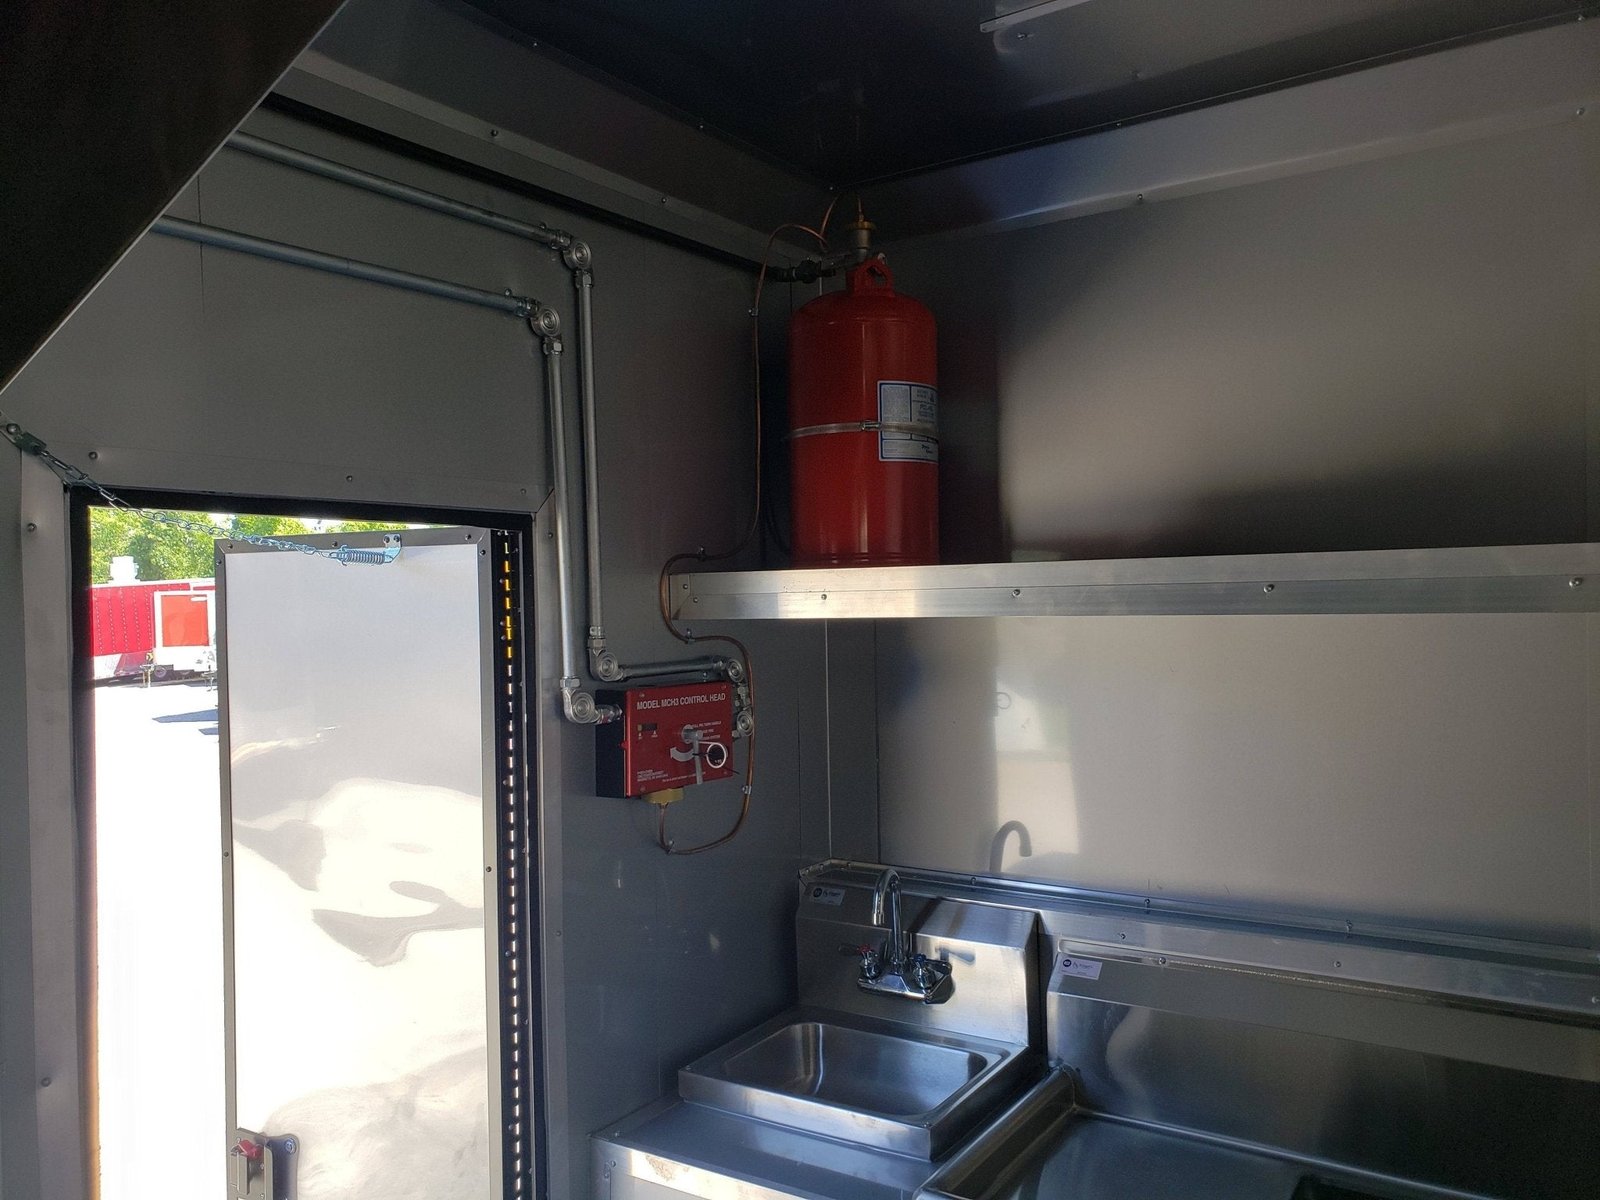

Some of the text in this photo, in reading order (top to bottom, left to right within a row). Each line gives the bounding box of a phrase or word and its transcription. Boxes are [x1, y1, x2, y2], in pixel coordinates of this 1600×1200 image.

[637, 693, 725, 710] MODEL MCH3 CONTROL HEAD
